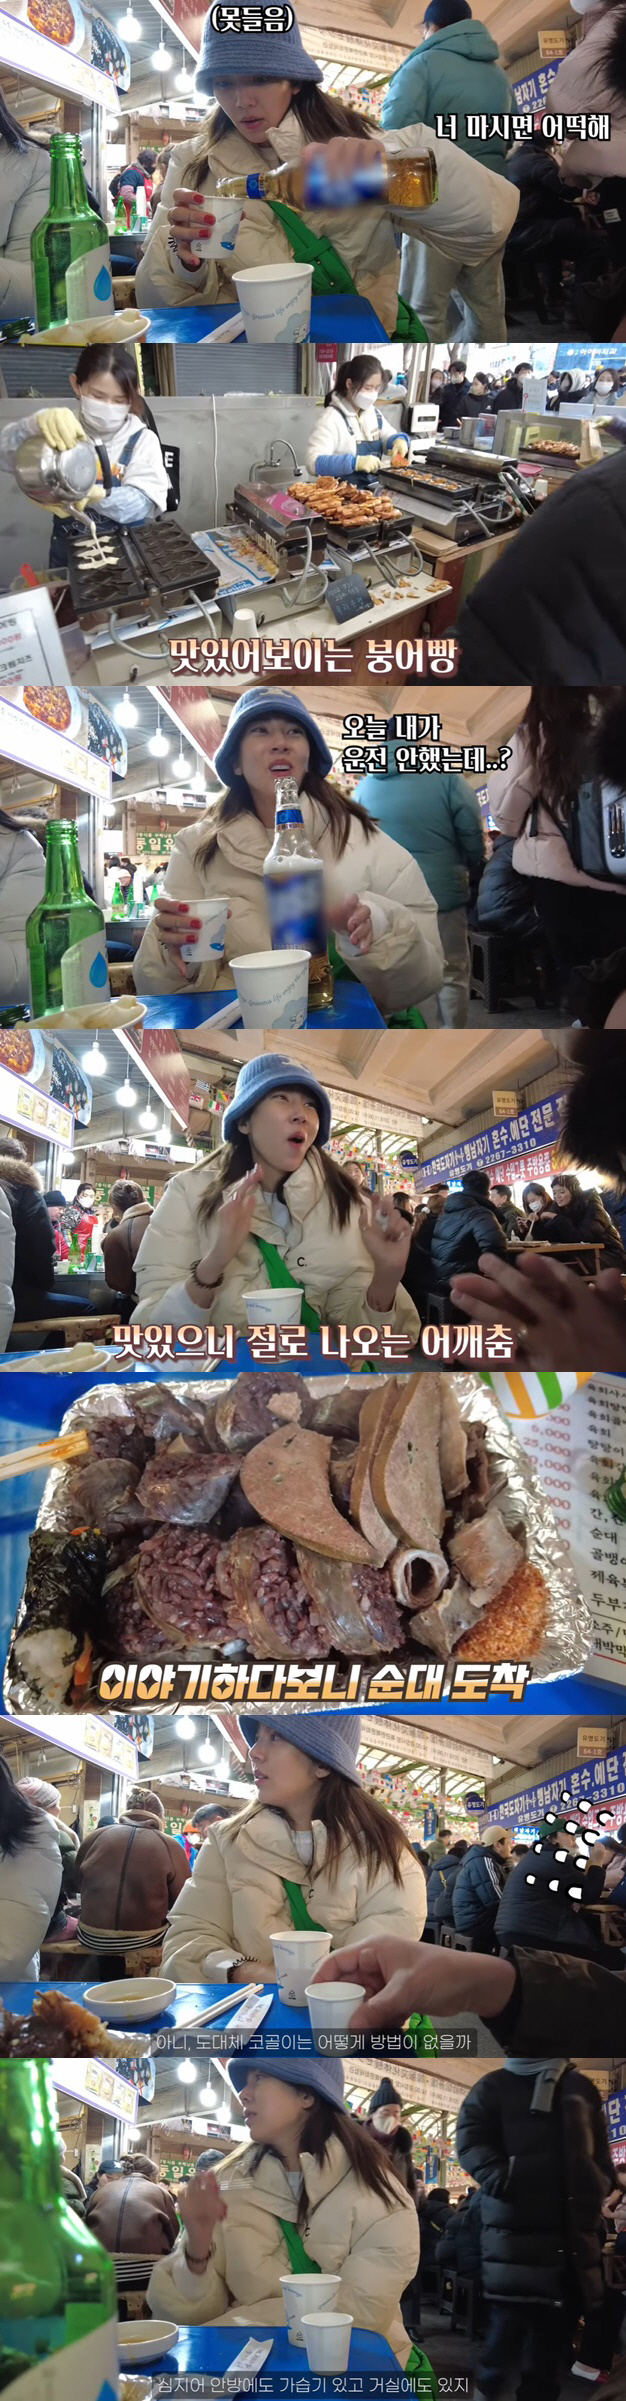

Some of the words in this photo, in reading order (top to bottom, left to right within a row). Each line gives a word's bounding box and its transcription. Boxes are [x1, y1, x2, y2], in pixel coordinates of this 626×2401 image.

[530, 1102, 555, 1133] 전문
[485, 1137, 537, 1163] 2267-3310
[526, 1151, 551, 1177] 주방용품
[590, 1528, 618, 1545] 순대
[581, 1735, 606, 1743] 유명도기
[537, 1777, 568, 1807] 행남자기
[570, 1755, 620, 1796] 혼수.예단
[517, 1807, 546, 1824] 유명도기
